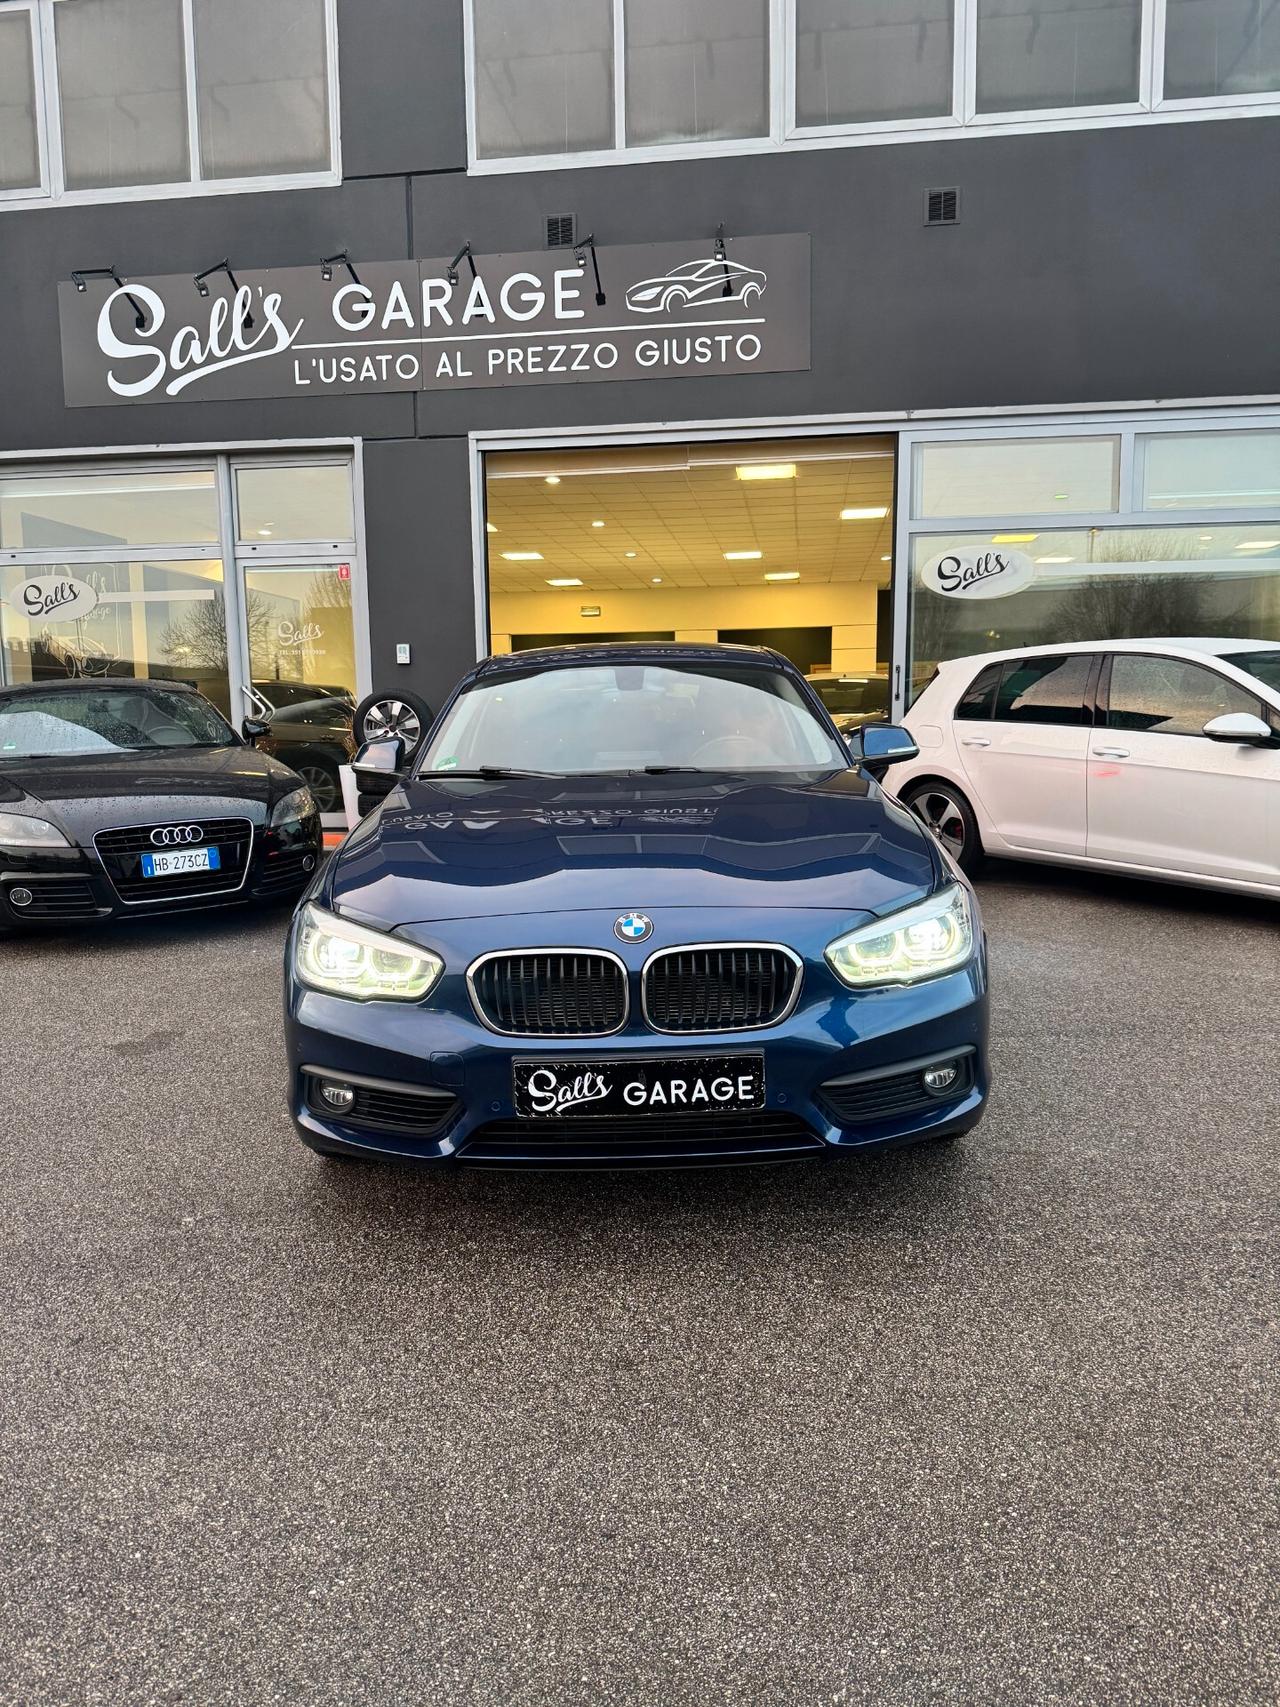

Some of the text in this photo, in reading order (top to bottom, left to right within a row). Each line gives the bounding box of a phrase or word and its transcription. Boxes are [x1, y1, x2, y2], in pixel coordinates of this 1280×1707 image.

[97, 268, 586, 397] Sall's GARAGE
[294, 333, 762, 385] L'USATO AL PREZZO GIUSTO
[937, 552, 1011, 593] Sall's
[23, 581, 81, 616] Sall's
[528, 1069, 755, 1113] Sall's GARAGE
